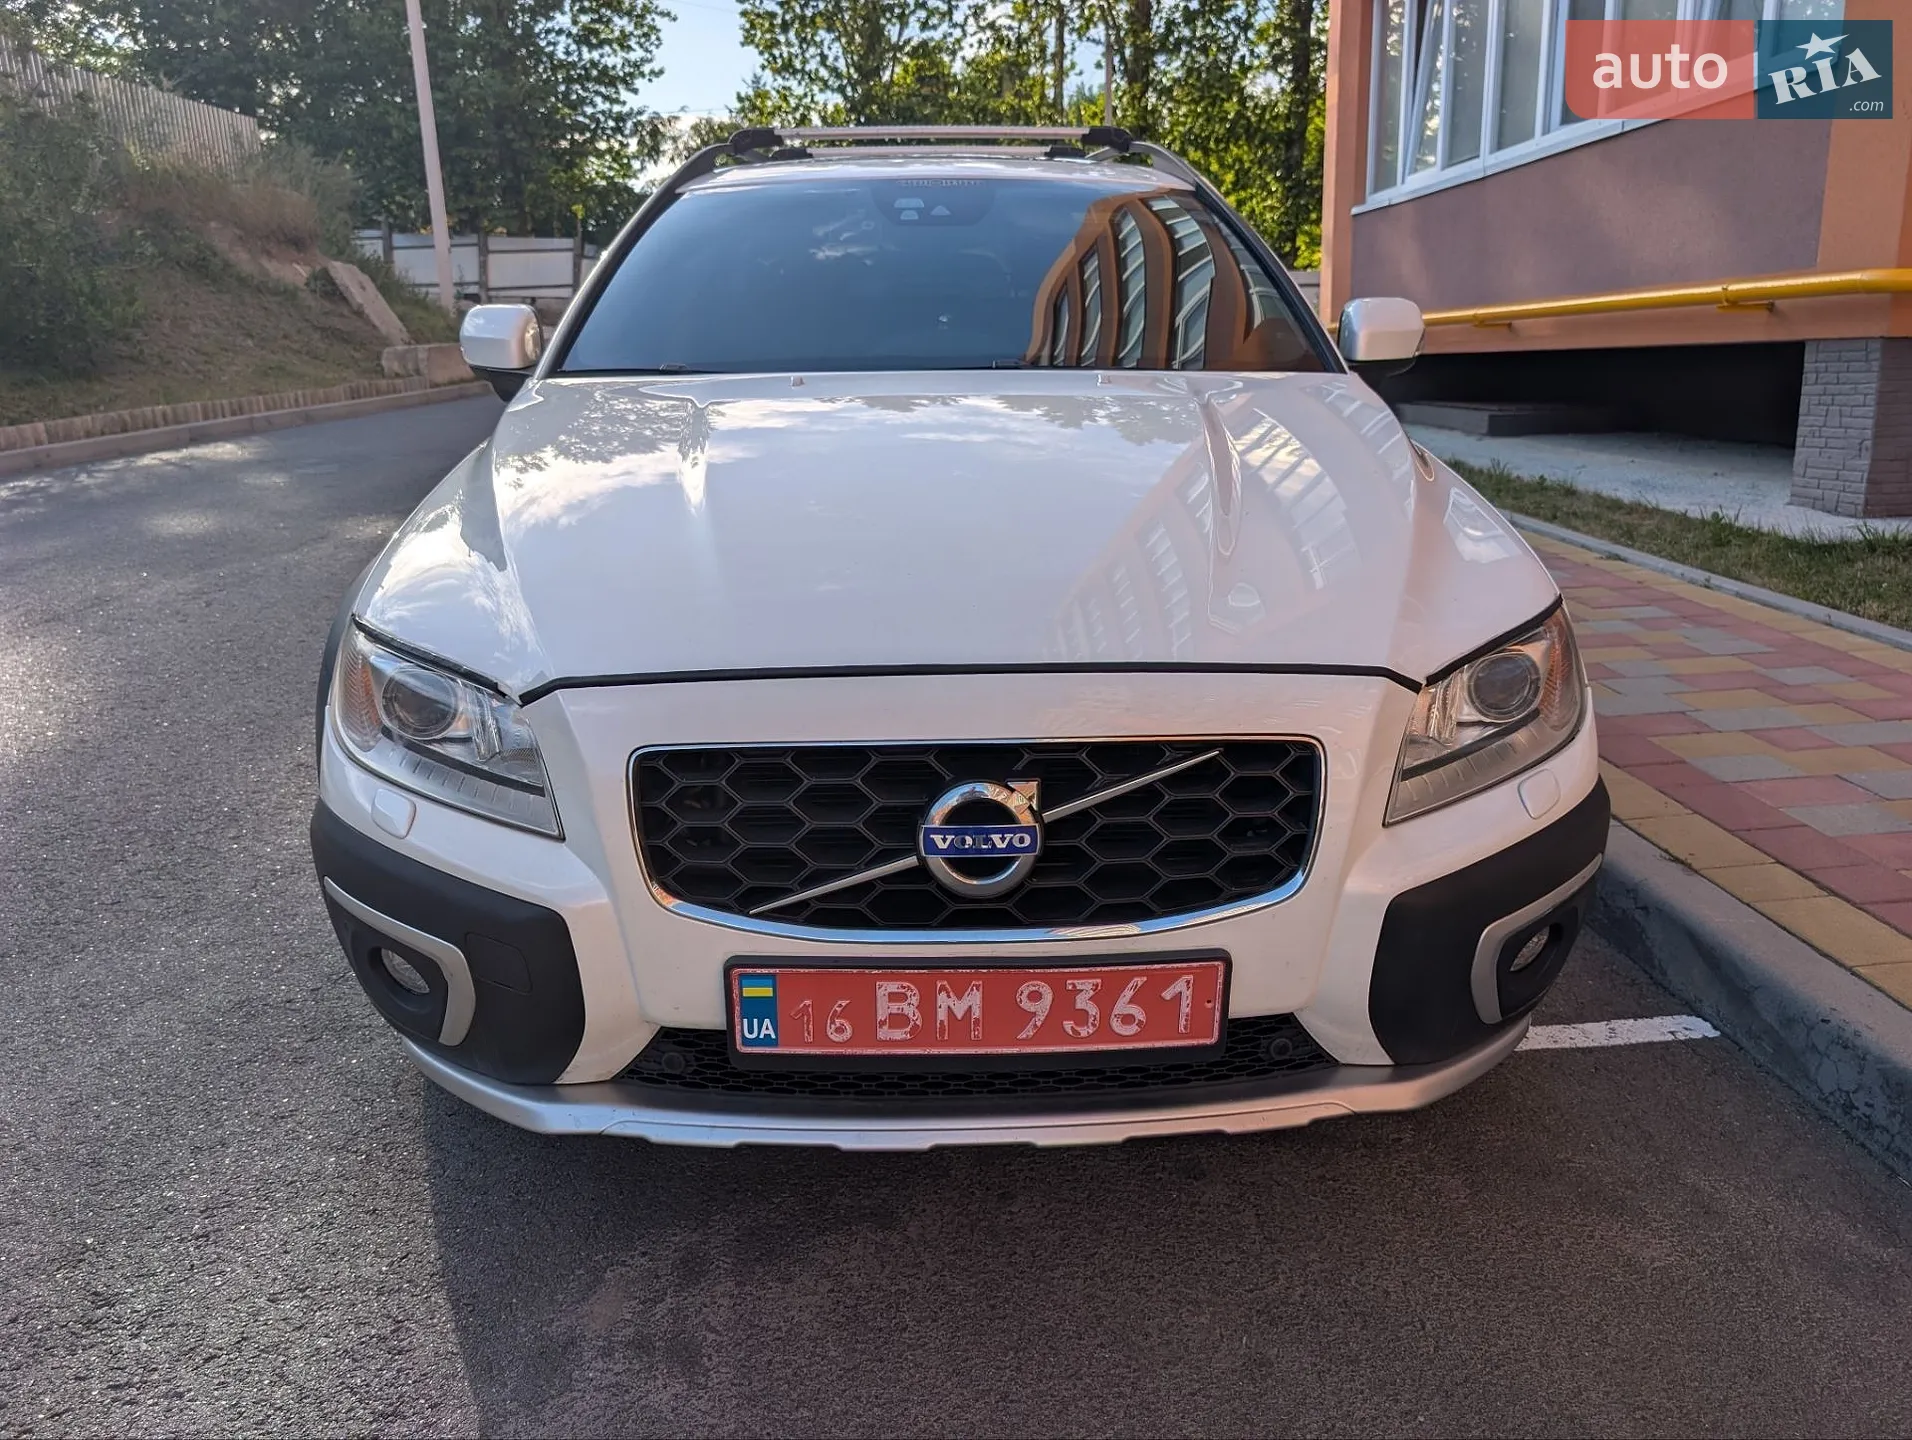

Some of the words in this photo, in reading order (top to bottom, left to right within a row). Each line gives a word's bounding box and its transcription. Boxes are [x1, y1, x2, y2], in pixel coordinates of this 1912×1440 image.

[930, 832, 1031, 849] VOLVO
[790, 1000, 853, 1043] 16
[876, 980, 983, 1042] BM
[1015, 975, 1194, 1040] 9361
[742, 1017, 776, 1040] UA
